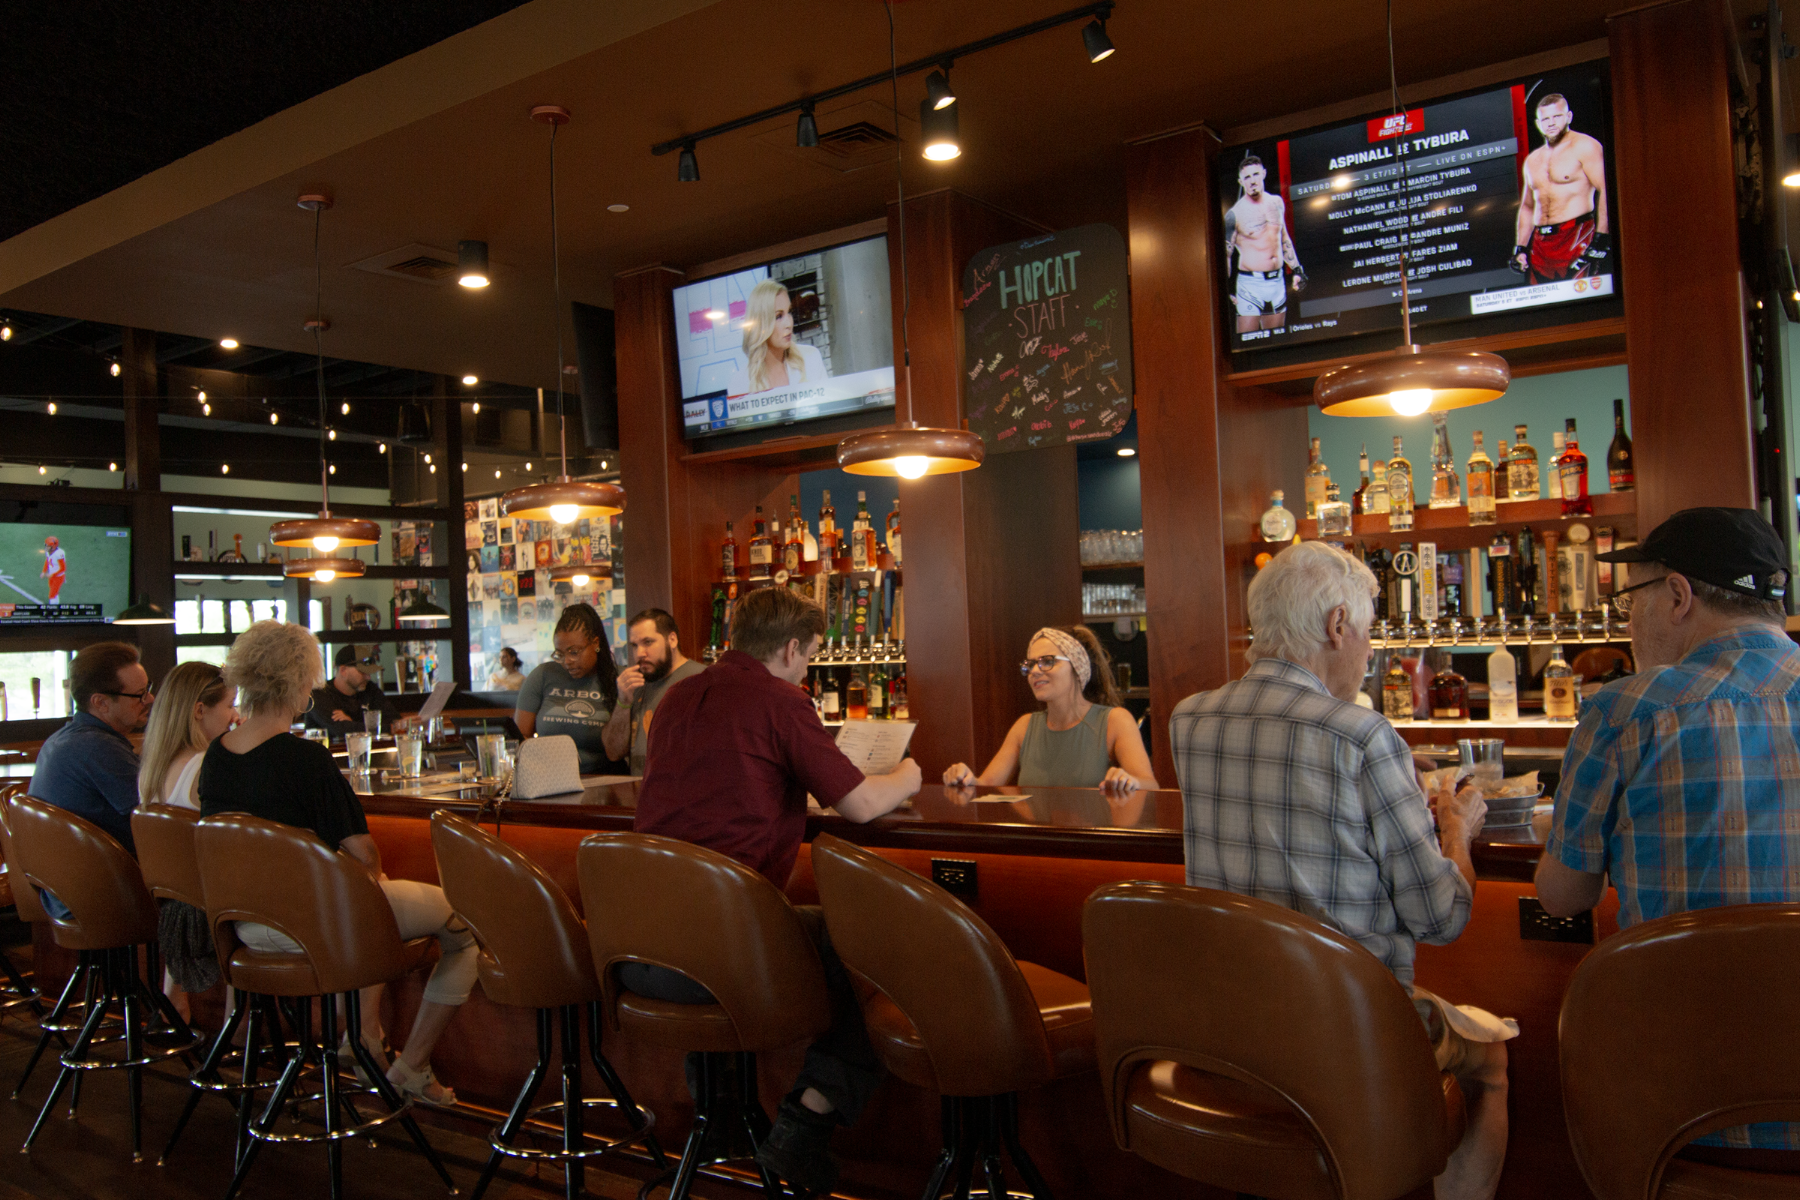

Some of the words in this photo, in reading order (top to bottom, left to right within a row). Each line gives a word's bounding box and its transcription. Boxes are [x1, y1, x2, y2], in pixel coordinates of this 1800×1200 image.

[1328, 146, 1392, 170] ASPINALL
[1412, 129, 1470, 151] TYBURA
[1298, 179, 1342, 195] SATURDA
[1372, 169, 1397, 179] ET/12
[1436, 156, 1456, 166] LIVE
[1477, 146, 1506, 157] ESPN+
[1336, 192, 1352, 201] TOM
[1354, 184, 1390, 198] ASPINALL
[1408, 173, 1438, 186] MARCIN
[1440, 167, 1471, 179] TYBURA
[1328, 209, 1353, 220] MOLLY
[1354, 203, 1386, 215] McCANN
[1423, 184, 1477, 200] STOLIARENKO
[1343, 221, 1385, 234] NATHANIEL
[1385, 216, 1409, 226] WOOD
[1420, 209, 1447, 220] ANDRE
[1448, 205, 1463, 215] FILI
[1354, 241, 1374, 250] PAUL
[1374, 236, 1398, 246] CRAIG
[1416, 227, 1442, 239] ANDRE
[1443, 222, 1470, 234] MUNIZ
[1353, 260, 1365, 268] JAI
[1365, 253, 1400, 266] HERBERT
[1412, 247, 1436, 258] FARES
[1438, 242, 1458, 253] ZIAM
[999, 250, 1081, 310] HOPCAT
[1342, 276, 1371, 288] LERONE
[1372, 271, 1401, 282] MURPH
[1417, 265, 1436, 275] JOSH
[1476, 294, 1491, 302] MAN
[1492, 291, 1518, 300] UNITED
[1528, 284, 1560, 294] ARSENAL
[1014, 294, 1071, 338] STAFF
[1292, 323, 1313, 332] Orioles
[1322, 320, 1337, 328] Rays
[729, 400, 749, 412] WHAT
[751, 399, 759, 408] TO
[761, 396, 788, 407] EXPECT
[799, 388, 825, 401] PAC-12
[1734, 579, 1756, 590] adidas
[549, 688, 604, 700] ARBO
[543, 716, 579, 724] BREWING
